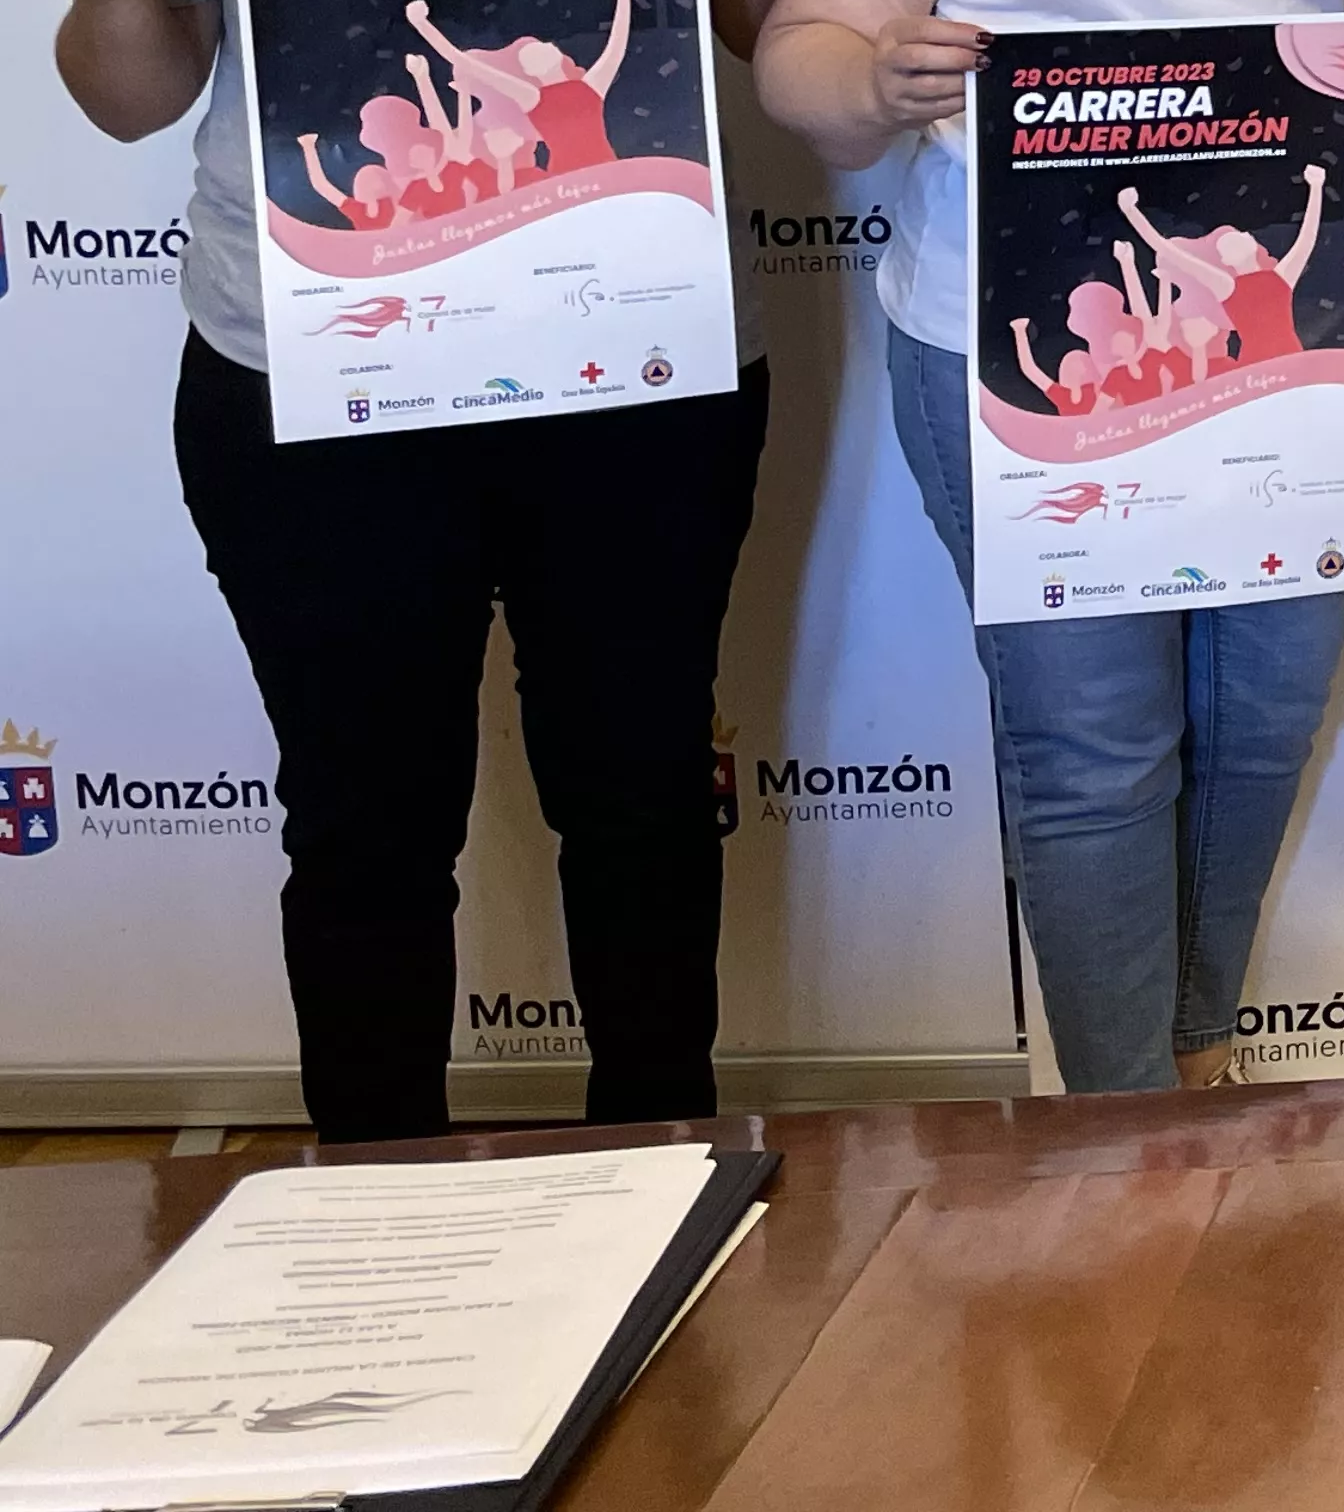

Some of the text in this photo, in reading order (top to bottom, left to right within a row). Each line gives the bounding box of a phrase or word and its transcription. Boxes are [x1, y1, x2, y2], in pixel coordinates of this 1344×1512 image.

[1012, 63, 1215, 87] 29 OCTUBRE 2023
[1013, 86, 1214, 124] CARRERA
[1012, 110, 1289, 155] MUJER MONZÓN
[1012, 158, 1089, 169] INSCRIPCIONES
[1090, 158, 1104, 166] EN
[750, 205, 892, 248] onzó
[25, 219, 190, 259] Monzó
[755, 251, 877, 274] untamie
[32, 265, 180, 290] Ayuntamie
[379, 394, 435, 411] Monzón
[452, 388, 544, 410] CincaMedio
[1072, 582, 1125, 596] Monzón
[1141, 579, 1226, 598] CincaMedio
[757, 754, 951, 797] Monzón
[76, 771, 268, 810] Monzón
[760, 799, 953, 823] Ayuntamiento
[81, 814, 271, 838] Ayuntamiento
[469, 993, 582, 1029] Mon
[474, 1034, 588, 1058] Ayuntam
